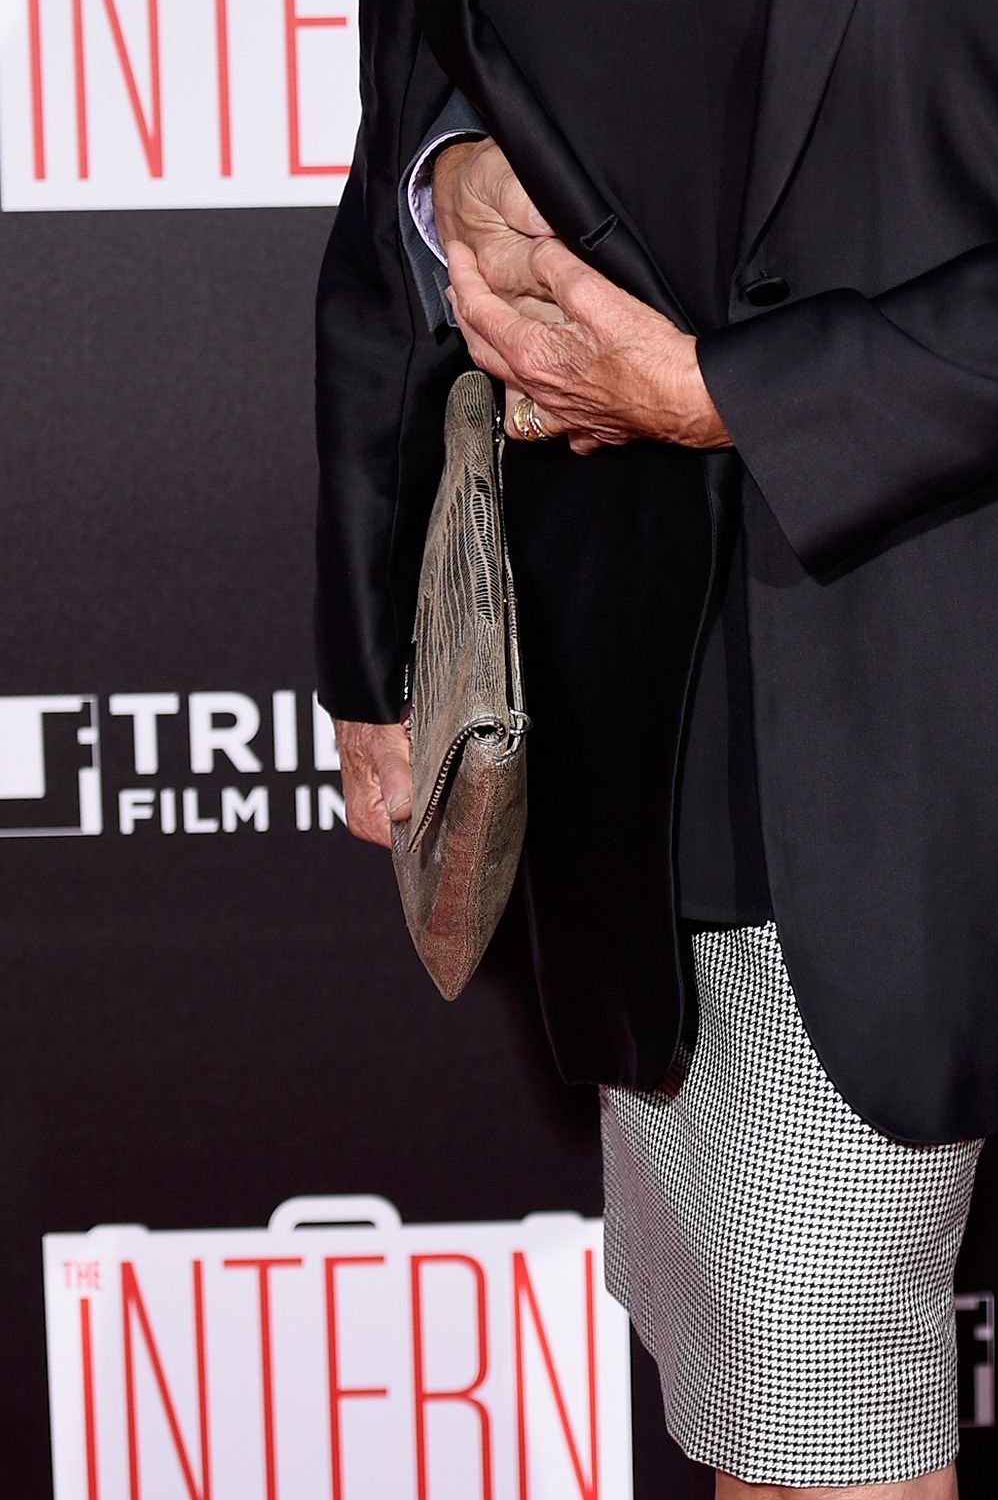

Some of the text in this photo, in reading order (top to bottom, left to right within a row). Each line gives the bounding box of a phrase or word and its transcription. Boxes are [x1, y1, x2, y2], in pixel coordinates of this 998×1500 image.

[118, 786, 270, 835] FILM
[63, 1260, 103, 1290] THE
[80, 1250, 600, 1500] INTERN
